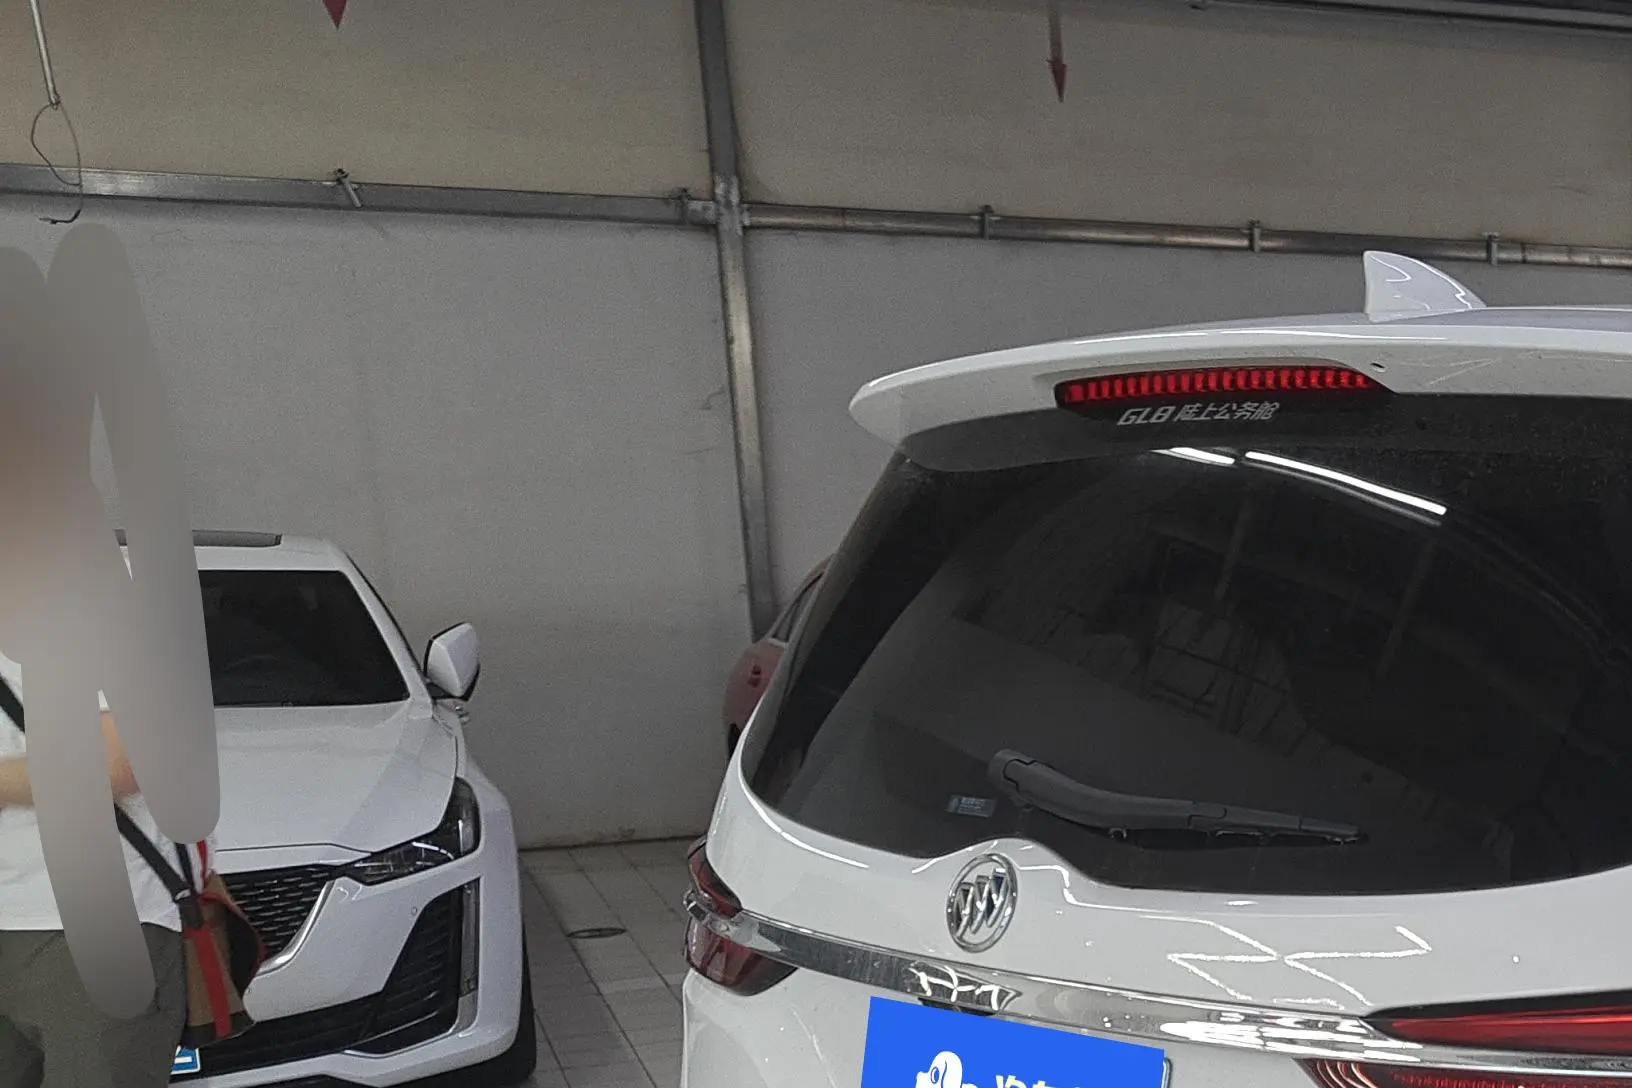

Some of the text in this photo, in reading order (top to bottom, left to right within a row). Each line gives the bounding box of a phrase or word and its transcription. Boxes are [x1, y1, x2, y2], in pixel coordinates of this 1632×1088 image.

[1117, 402, 1280, 425] GL8 陆上公务舱
